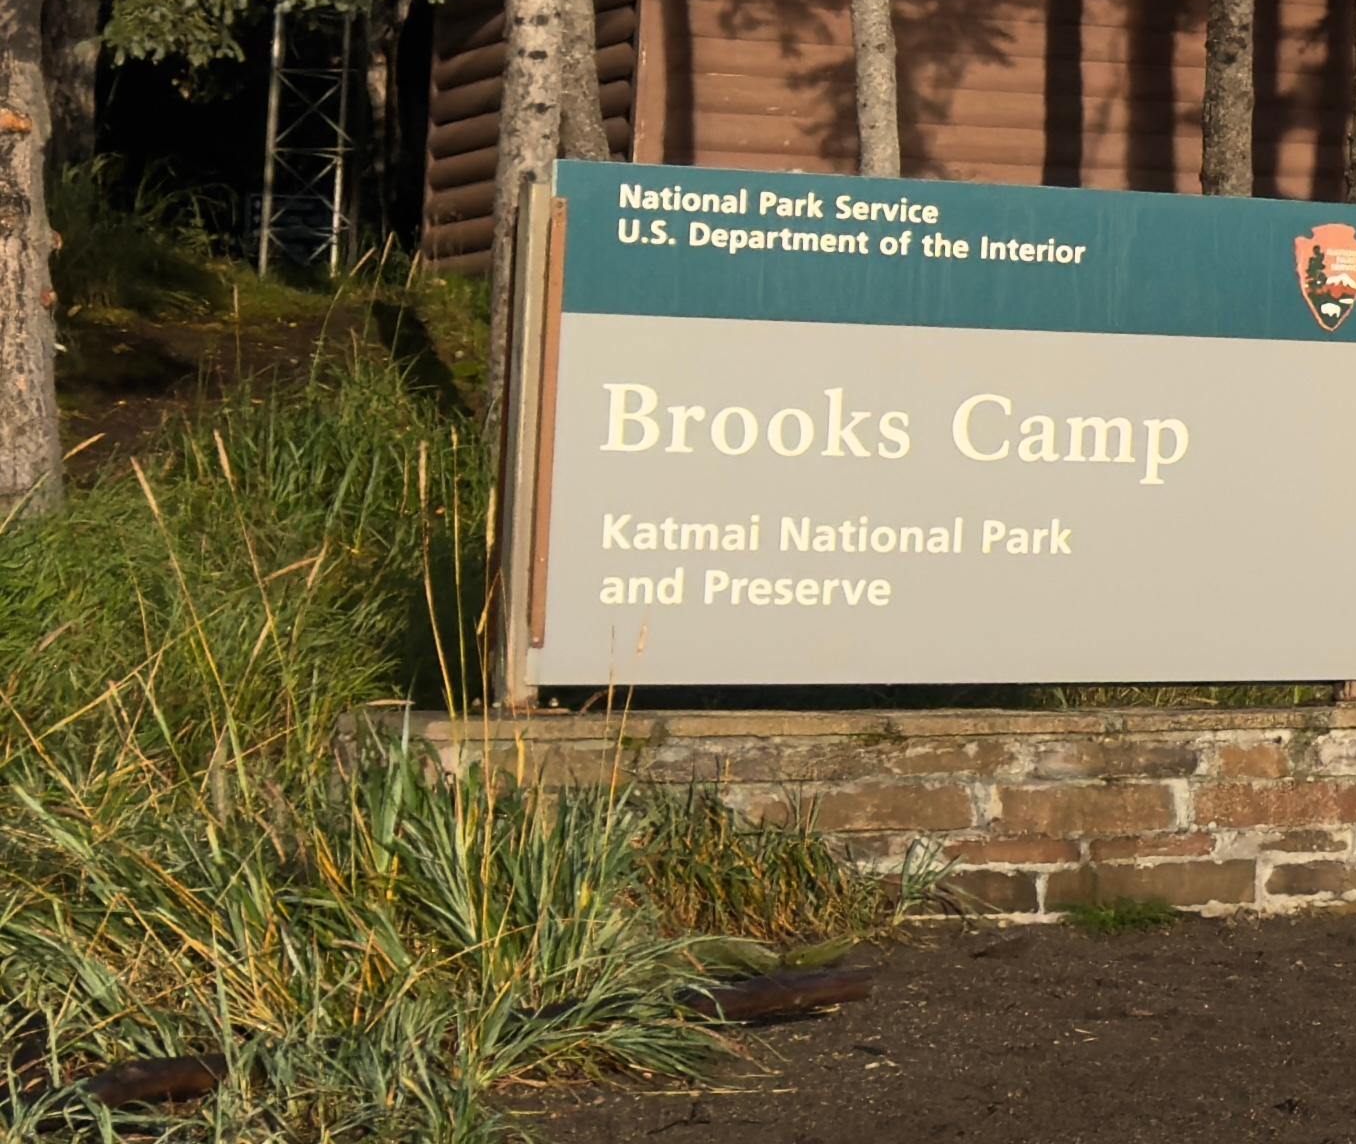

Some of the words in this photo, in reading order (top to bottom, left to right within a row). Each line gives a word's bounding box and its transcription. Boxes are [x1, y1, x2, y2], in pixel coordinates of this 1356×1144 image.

[619, 183, 749, 215] National
[759, 191, 824, 219] Park
[835, 194, 939, 224] Service
[618, 217, 677, 246] U.S.
[689, 222, 870, 255] Department
[879, 231, 913, 256] of
[921, 231, 970, 259] the
[980, 235, 1087, 264] Interior
[599, 383, 910, 460] Brooks
[952, 394, 1189, 484] Camp
[601, 513, 759, 551] Katmai
[779, 516, 964, 554] National
[982, 518, 1072, 554] Park
[599, 566, 684, 605] and
[704, 569, 891, 606] Preserve
